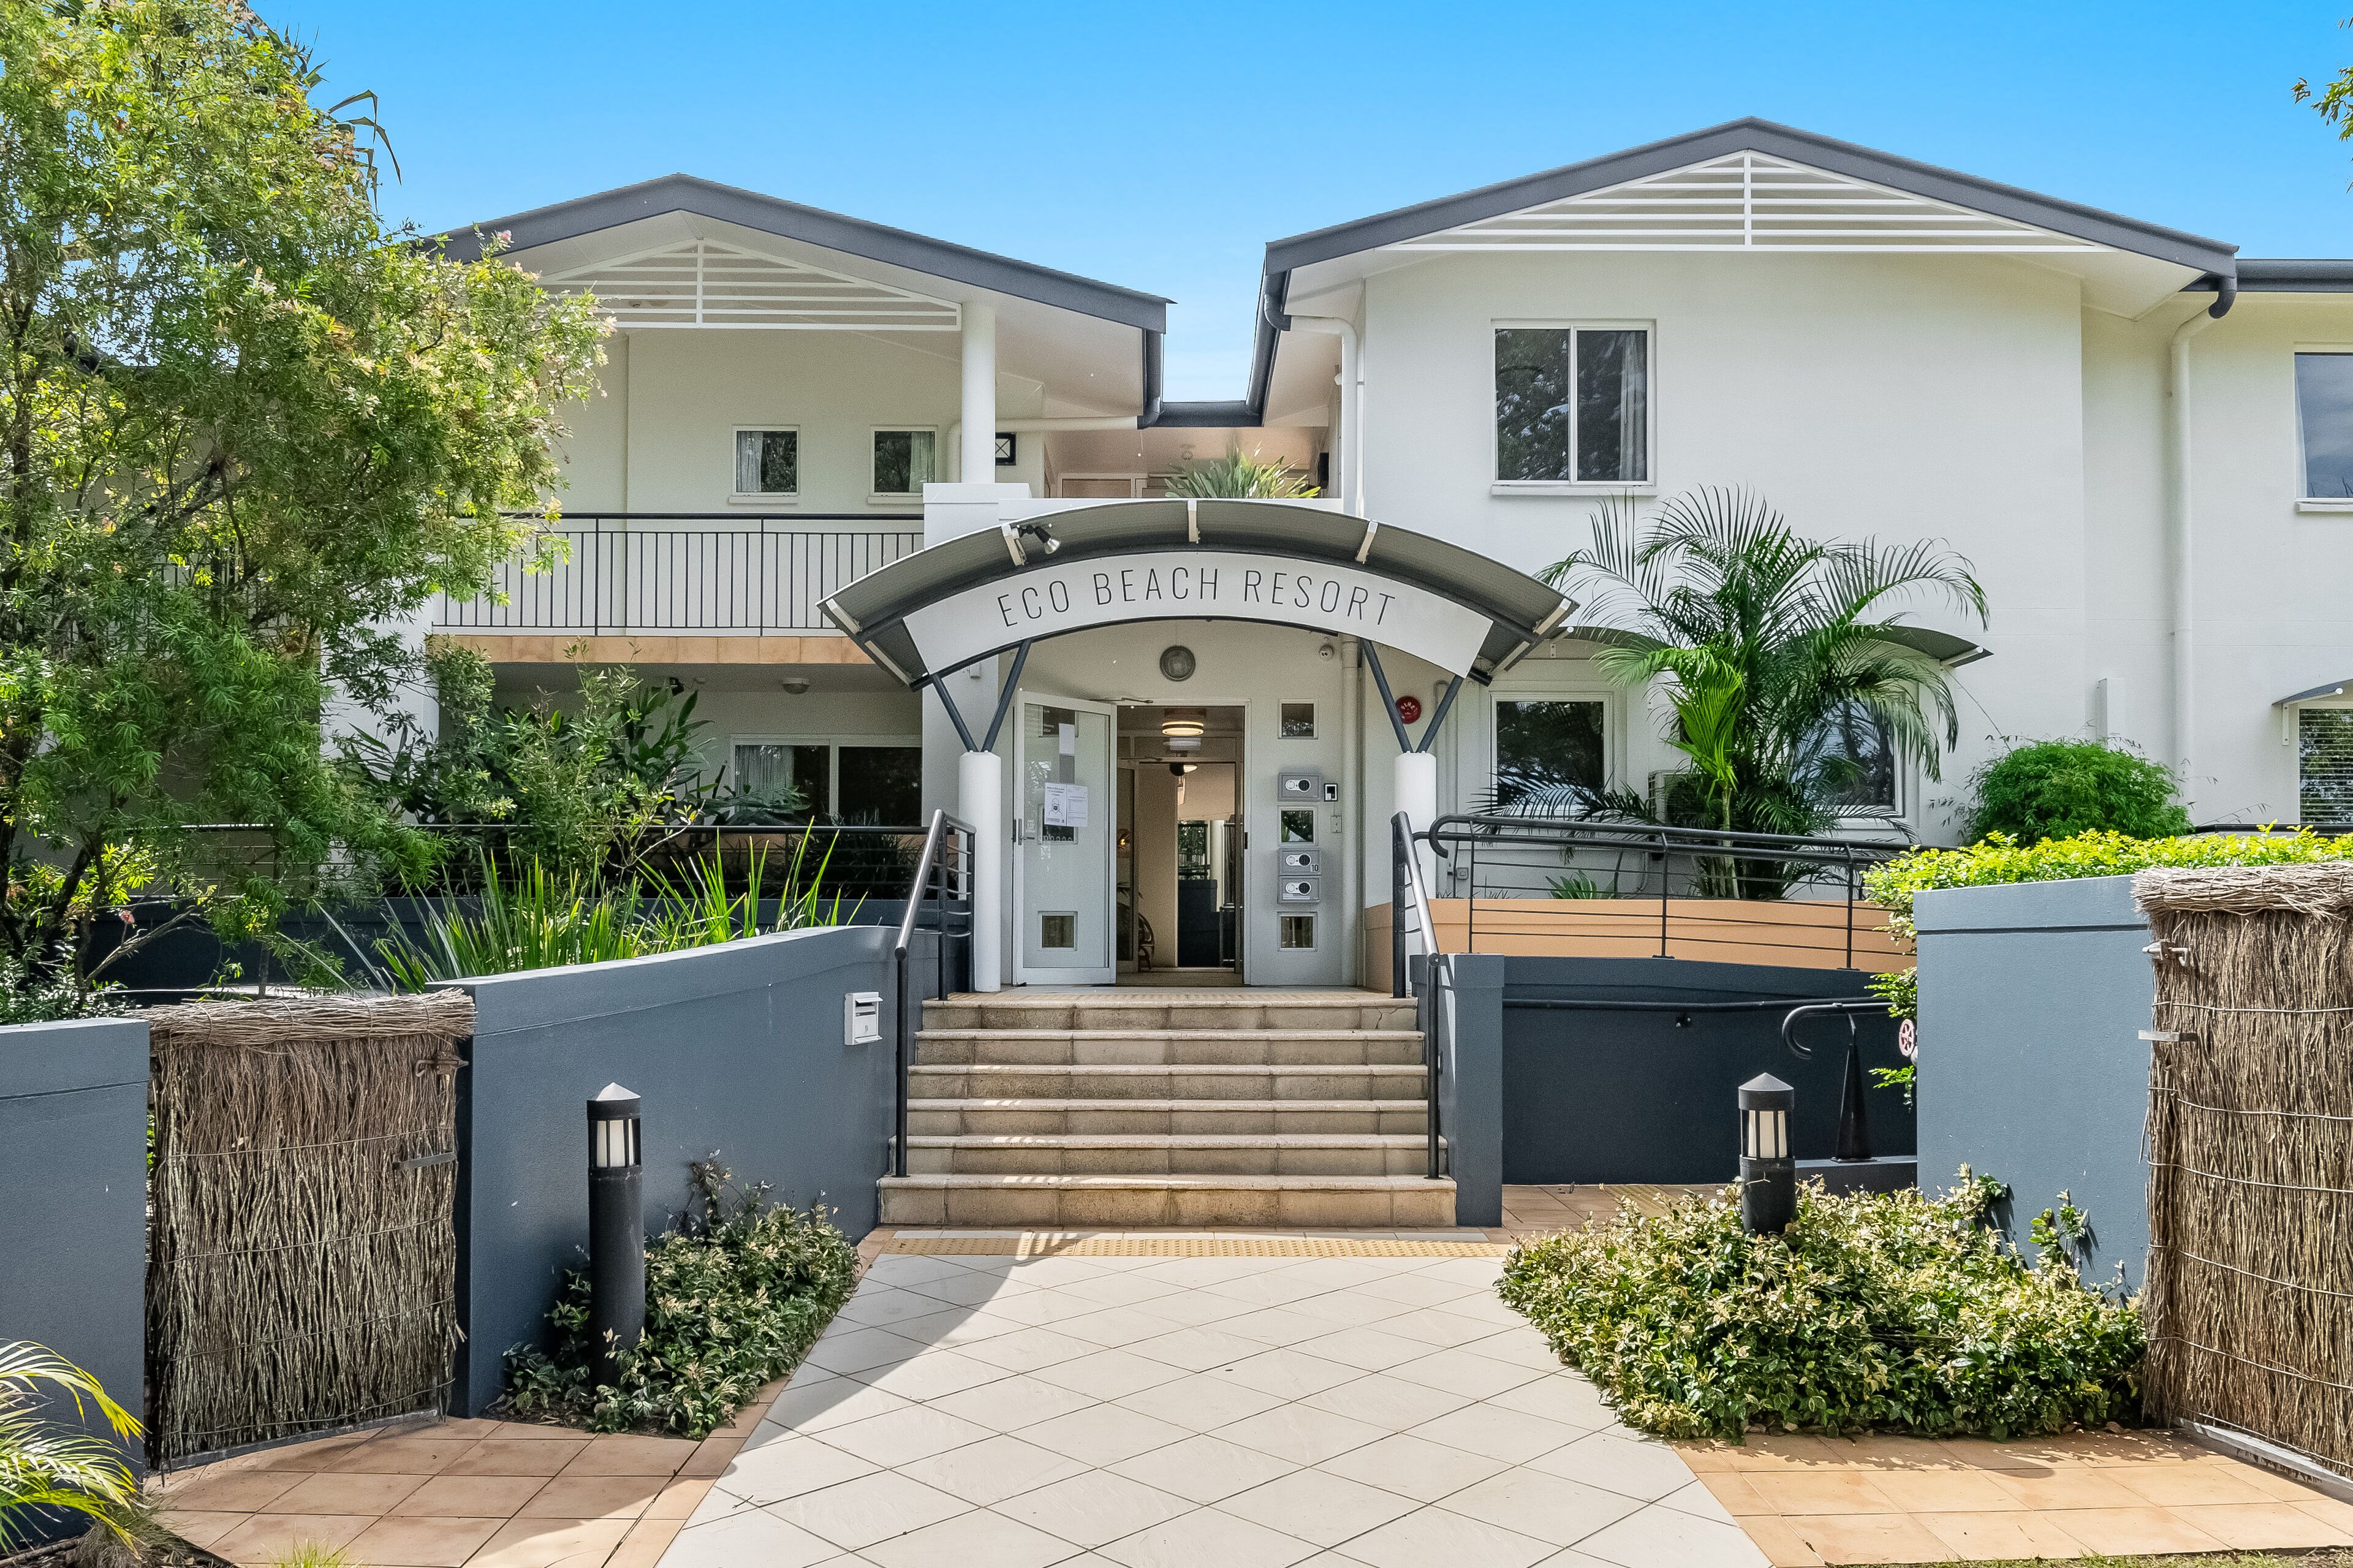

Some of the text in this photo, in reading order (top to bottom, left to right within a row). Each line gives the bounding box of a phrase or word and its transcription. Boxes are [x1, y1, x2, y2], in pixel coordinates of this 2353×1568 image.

[997, 567, 1395, 627] ECO BEACH RESORT
[1401, 702, 1415, 710] FIRE
